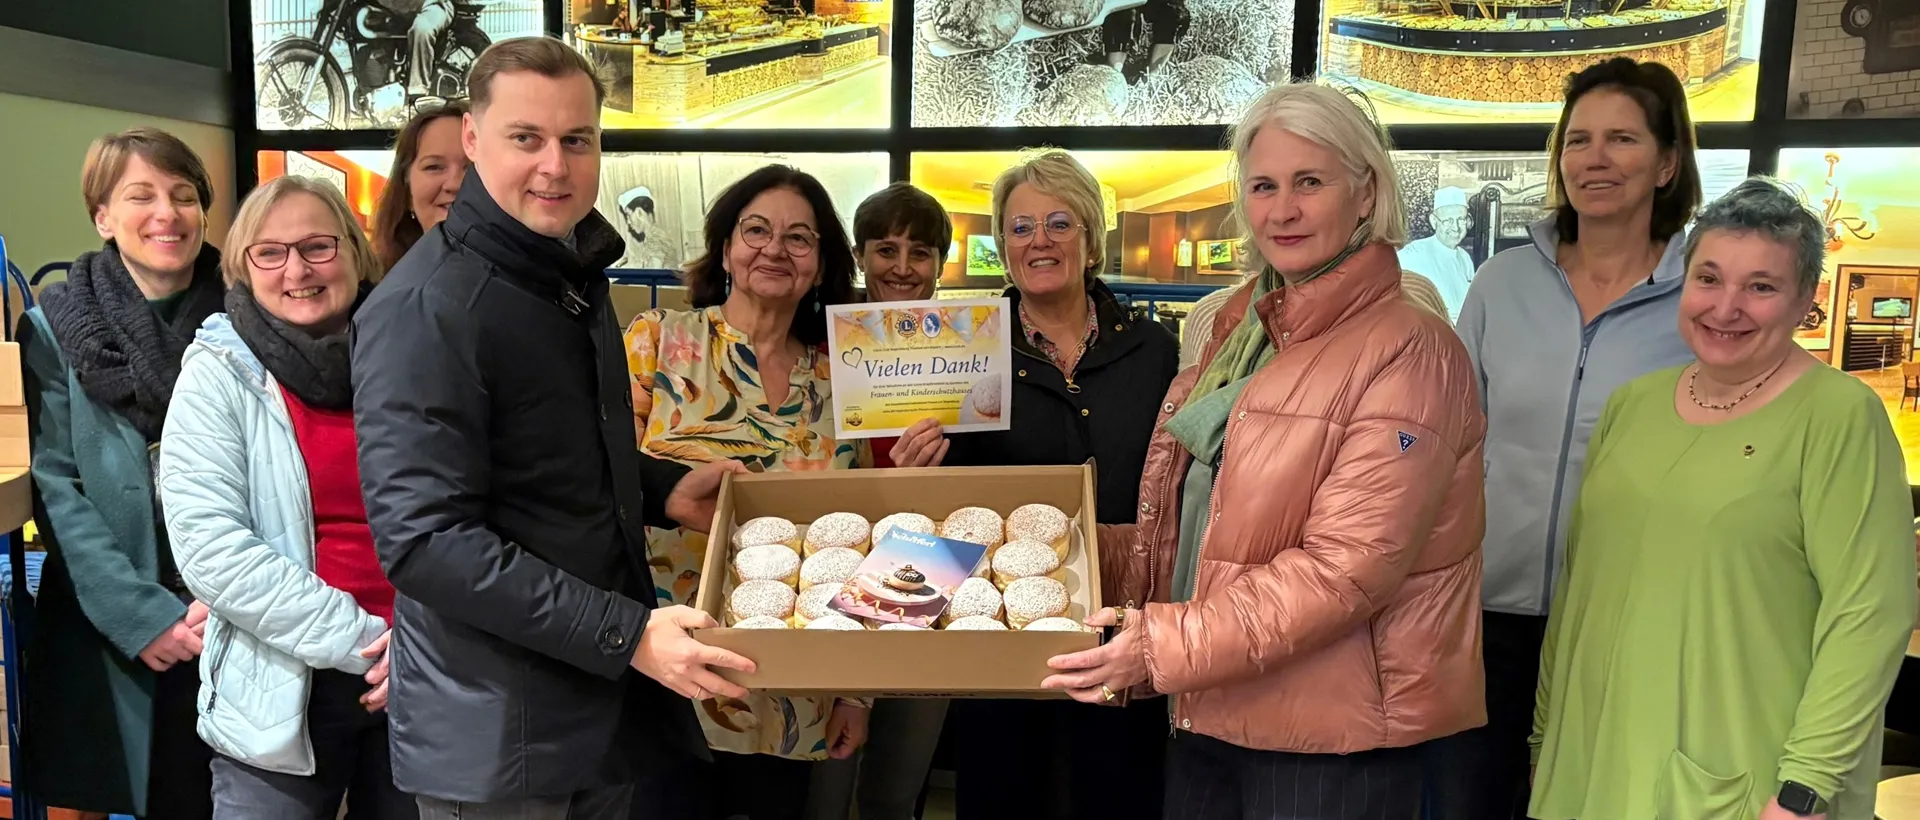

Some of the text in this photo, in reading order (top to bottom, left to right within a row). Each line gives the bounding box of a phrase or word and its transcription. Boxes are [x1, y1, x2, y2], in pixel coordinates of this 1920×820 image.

[864, 354, 989, 378] Vielen Dank!
[870, 387, 973, 399] Frauen- und Kinderschutzhauses
